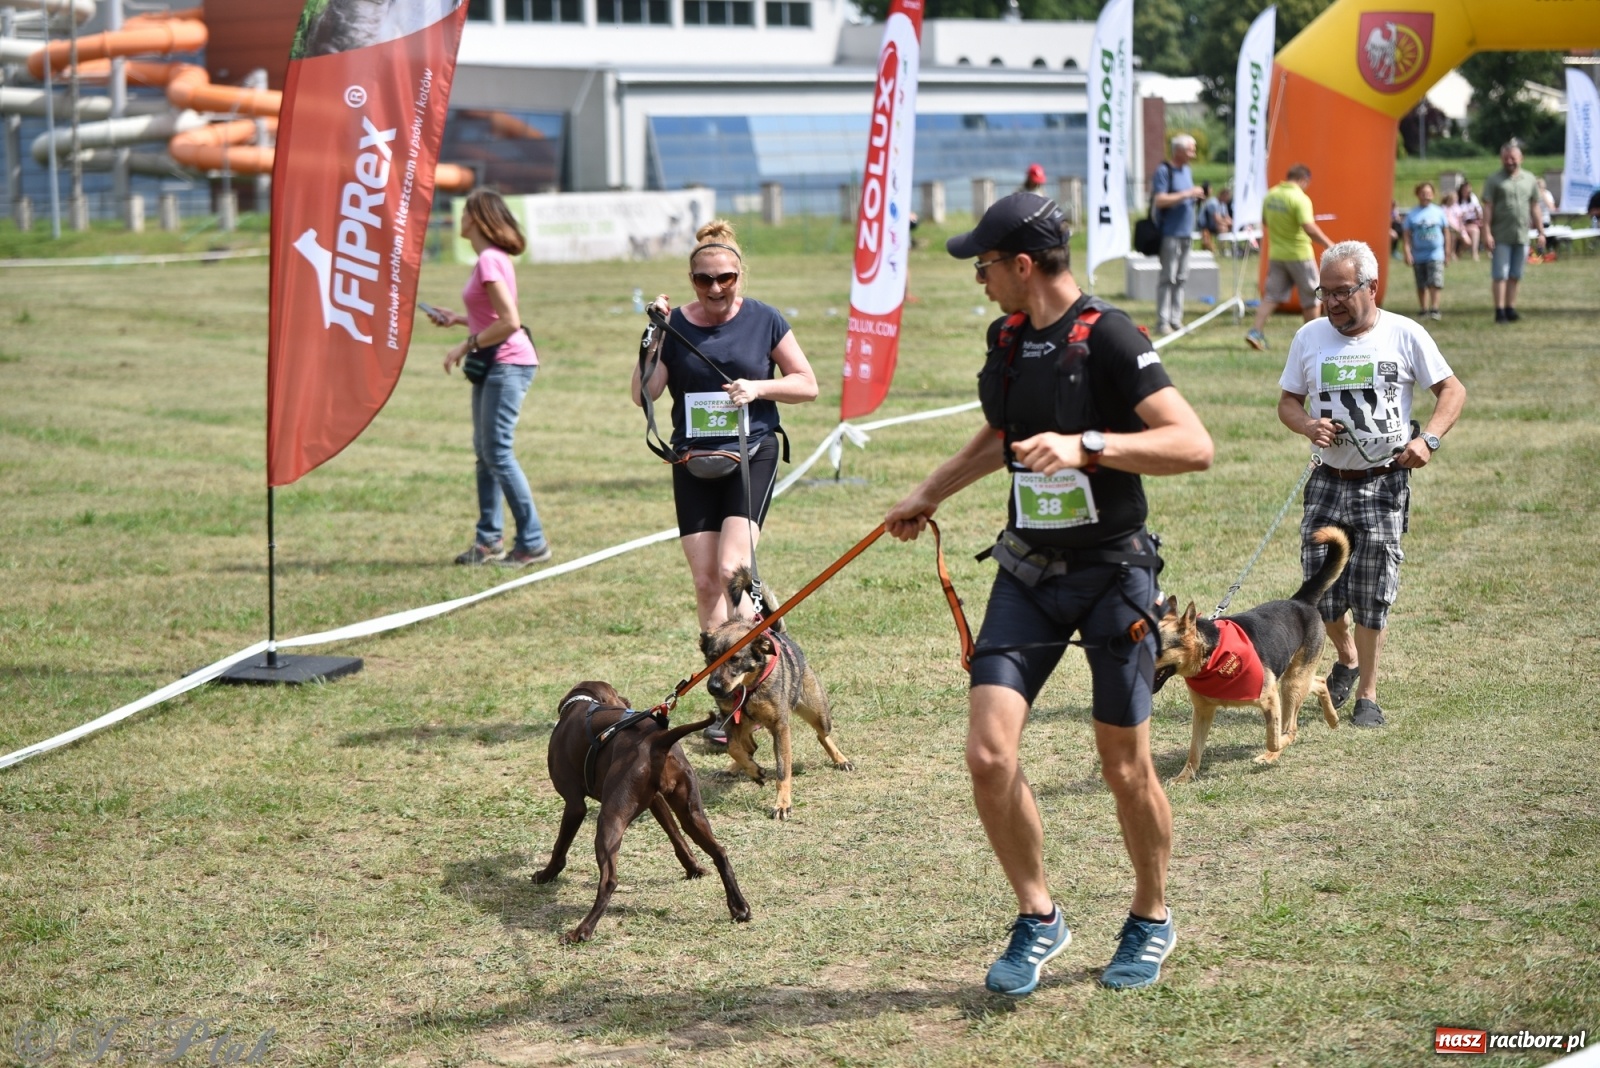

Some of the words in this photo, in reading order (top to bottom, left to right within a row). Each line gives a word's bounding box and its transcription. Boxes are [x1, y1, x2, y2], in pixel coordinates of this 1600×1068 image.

[415, 67, 433, 108] kotów
[410, 115, 424, 150] psów
[408, 148, 419, 158] u
[858, 75, 895, 253] ZOLUX
[394, 159, 417, 228] kleszczom
[333, 115, 397, 316] FIPRex
[387, 283, 400, 350] przeciwko
[1324, 354, 1372, 362] DOGTREKKING
[1337, 368, 1357, 382] 34
[707, 414, 728, 428] 36
[1329, 433, 1402, 448] ONSTER
[1020, 474, 1076, 483] DOGTREKKING
[1037, 497, 1062, 516] 38
[1218, 653, 1237, 675] Kochaj
